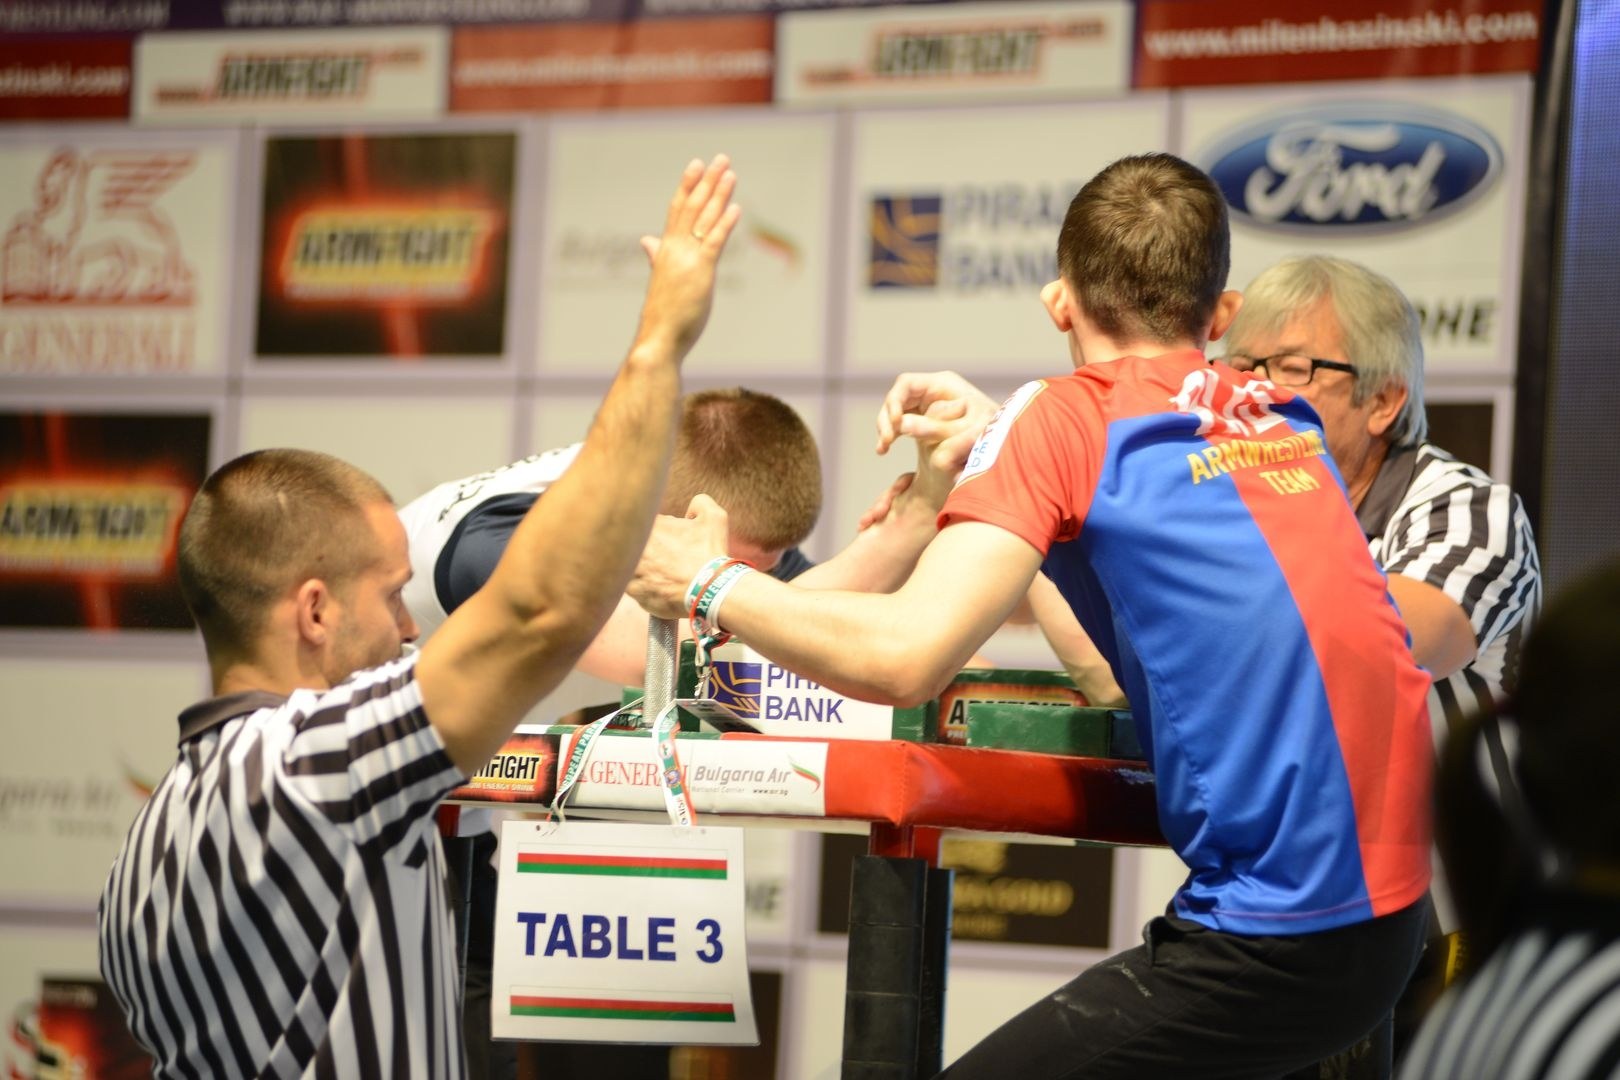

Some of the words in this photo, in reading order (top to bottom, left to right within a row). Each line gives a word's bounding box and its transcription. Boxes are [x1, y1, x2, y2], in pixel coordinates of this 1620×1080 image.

[1244, 121, 1446, 222] Ford
[1258, 467, 1321, 495] TEAM
[764, 695, 844, 724] BANK
[474, 755, 540, 780] FIGHT
[590, 760, 689, 787] GENERI
[694, 765, 765, 786] Bulgaria
[767, 768, 792, 784] Air
[517, 911, 677, 962] TABLE
[695, 918, 724, 964] 3
